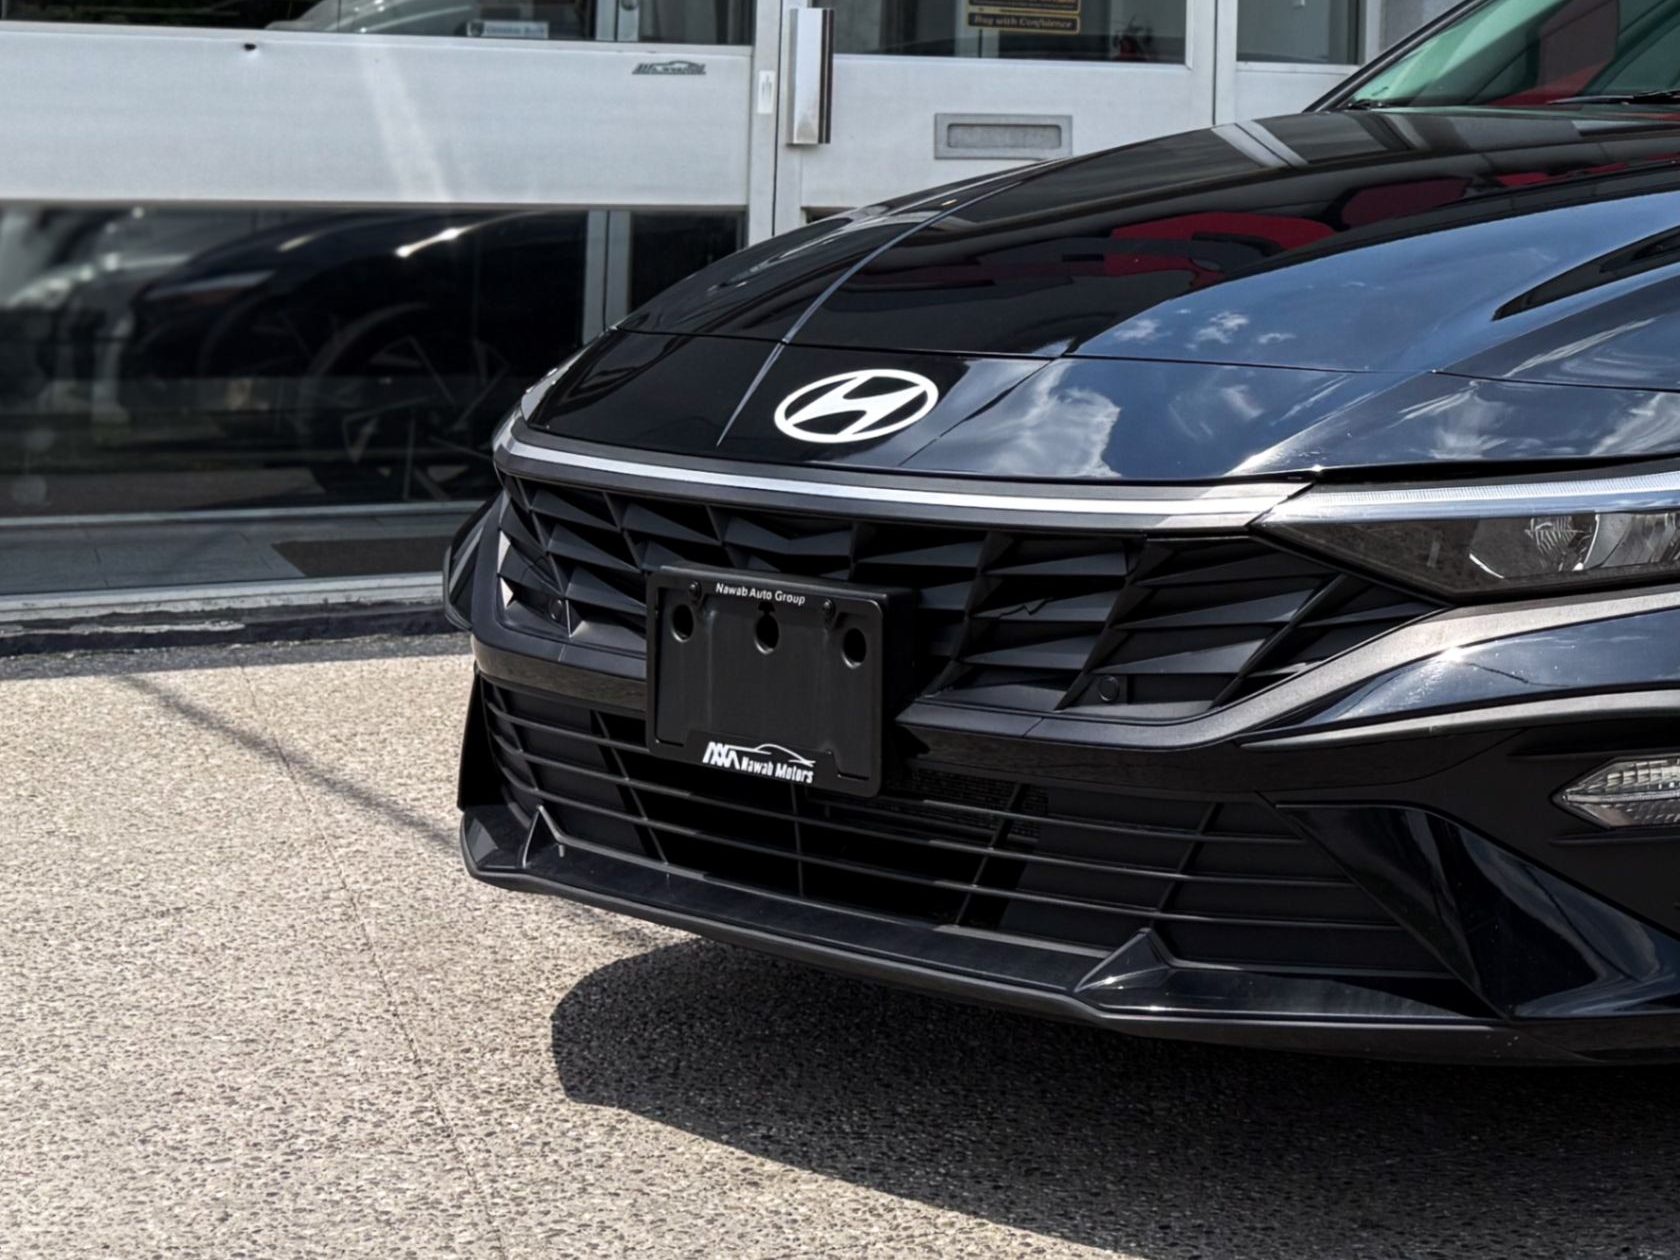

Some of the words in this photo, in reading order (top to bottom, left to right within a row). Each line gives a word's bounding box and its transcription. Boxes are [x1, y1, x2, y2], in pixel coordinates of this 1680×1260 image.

[715, 582, 748, 597] Nawab
[749, 587, 773, 601] Auto
[774, 590, 805, 606] Group
[741, 756, 774, 776] Nawab
[775, 762, 814, 783] Motors
